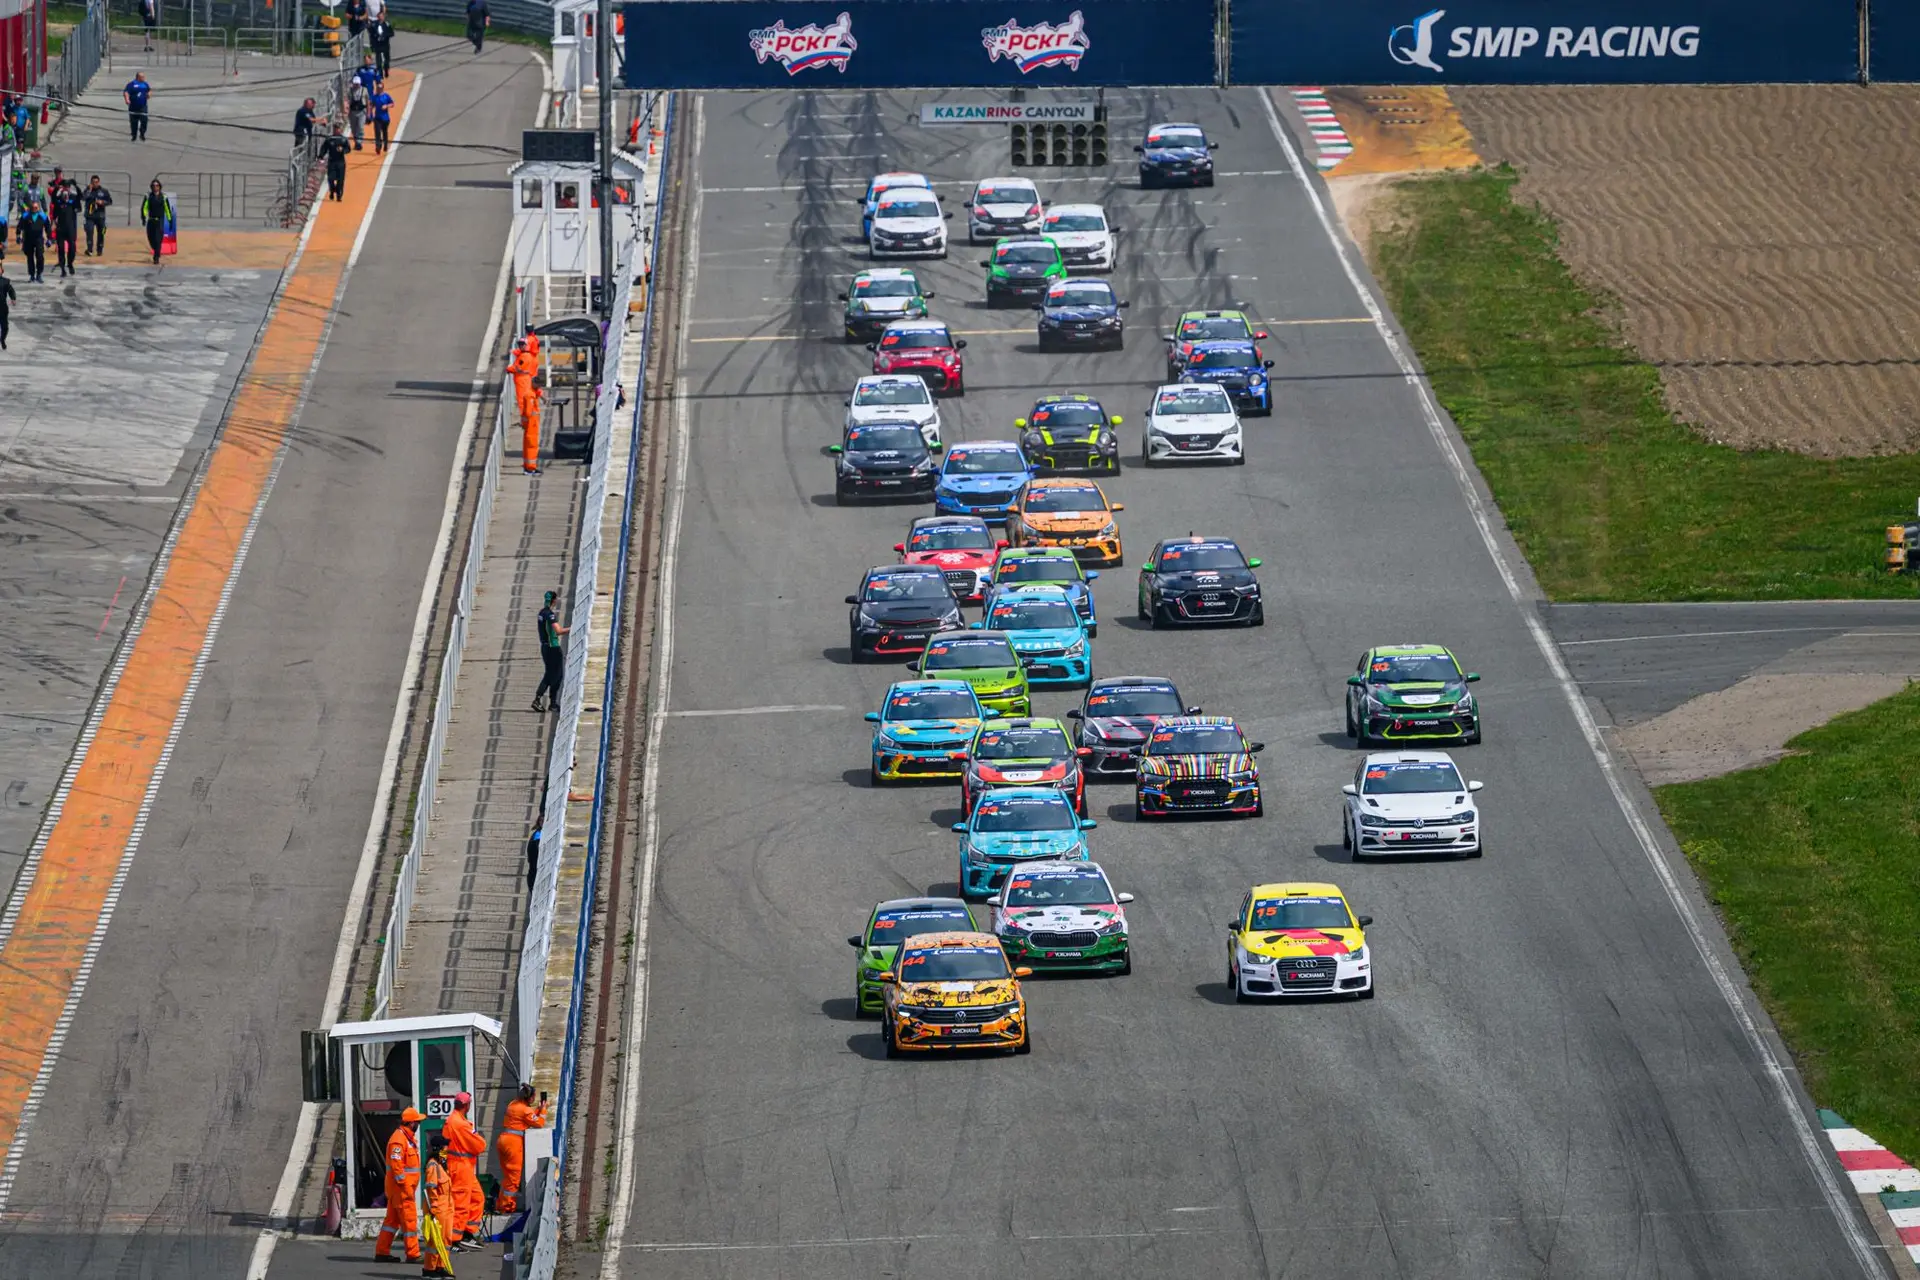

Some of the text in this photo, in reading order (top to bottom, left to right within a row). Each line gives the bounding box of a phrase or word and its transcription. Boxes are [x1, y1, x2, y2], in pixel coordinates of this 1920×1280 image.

[774, 32, 841, 52] РСКГ
[1006, 31, 1070, 51] РСКГ
[1448, 25, 1700, 58] SMP RACING
[934, 106, 1085, 118] KAZANRING CANYON
[1256, 907, 1278, 916] 15
[904, 956, 926, 966] 44
[430, 1099, 452, 1115] 30
